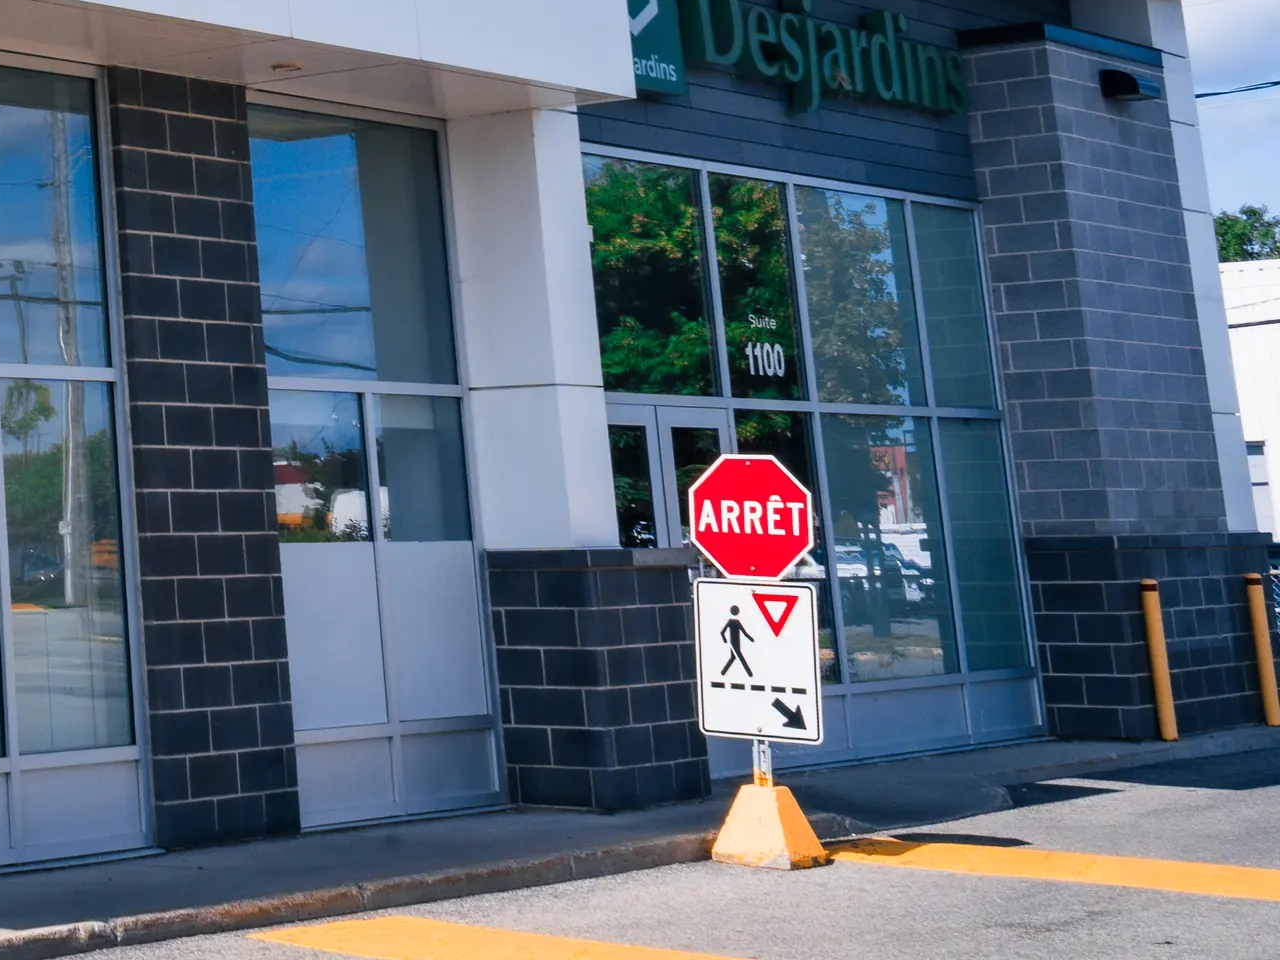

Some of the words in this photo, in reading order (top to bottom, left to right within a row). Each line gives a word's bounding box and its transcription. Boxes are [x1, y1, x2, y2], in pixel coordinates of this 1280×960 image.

[633, 53, 677, 81] ardins
[748, 314, 777, 330] Suite
[745, 342, 785, 377] 1100
[698, 495, 805, 536] ARRÊT
